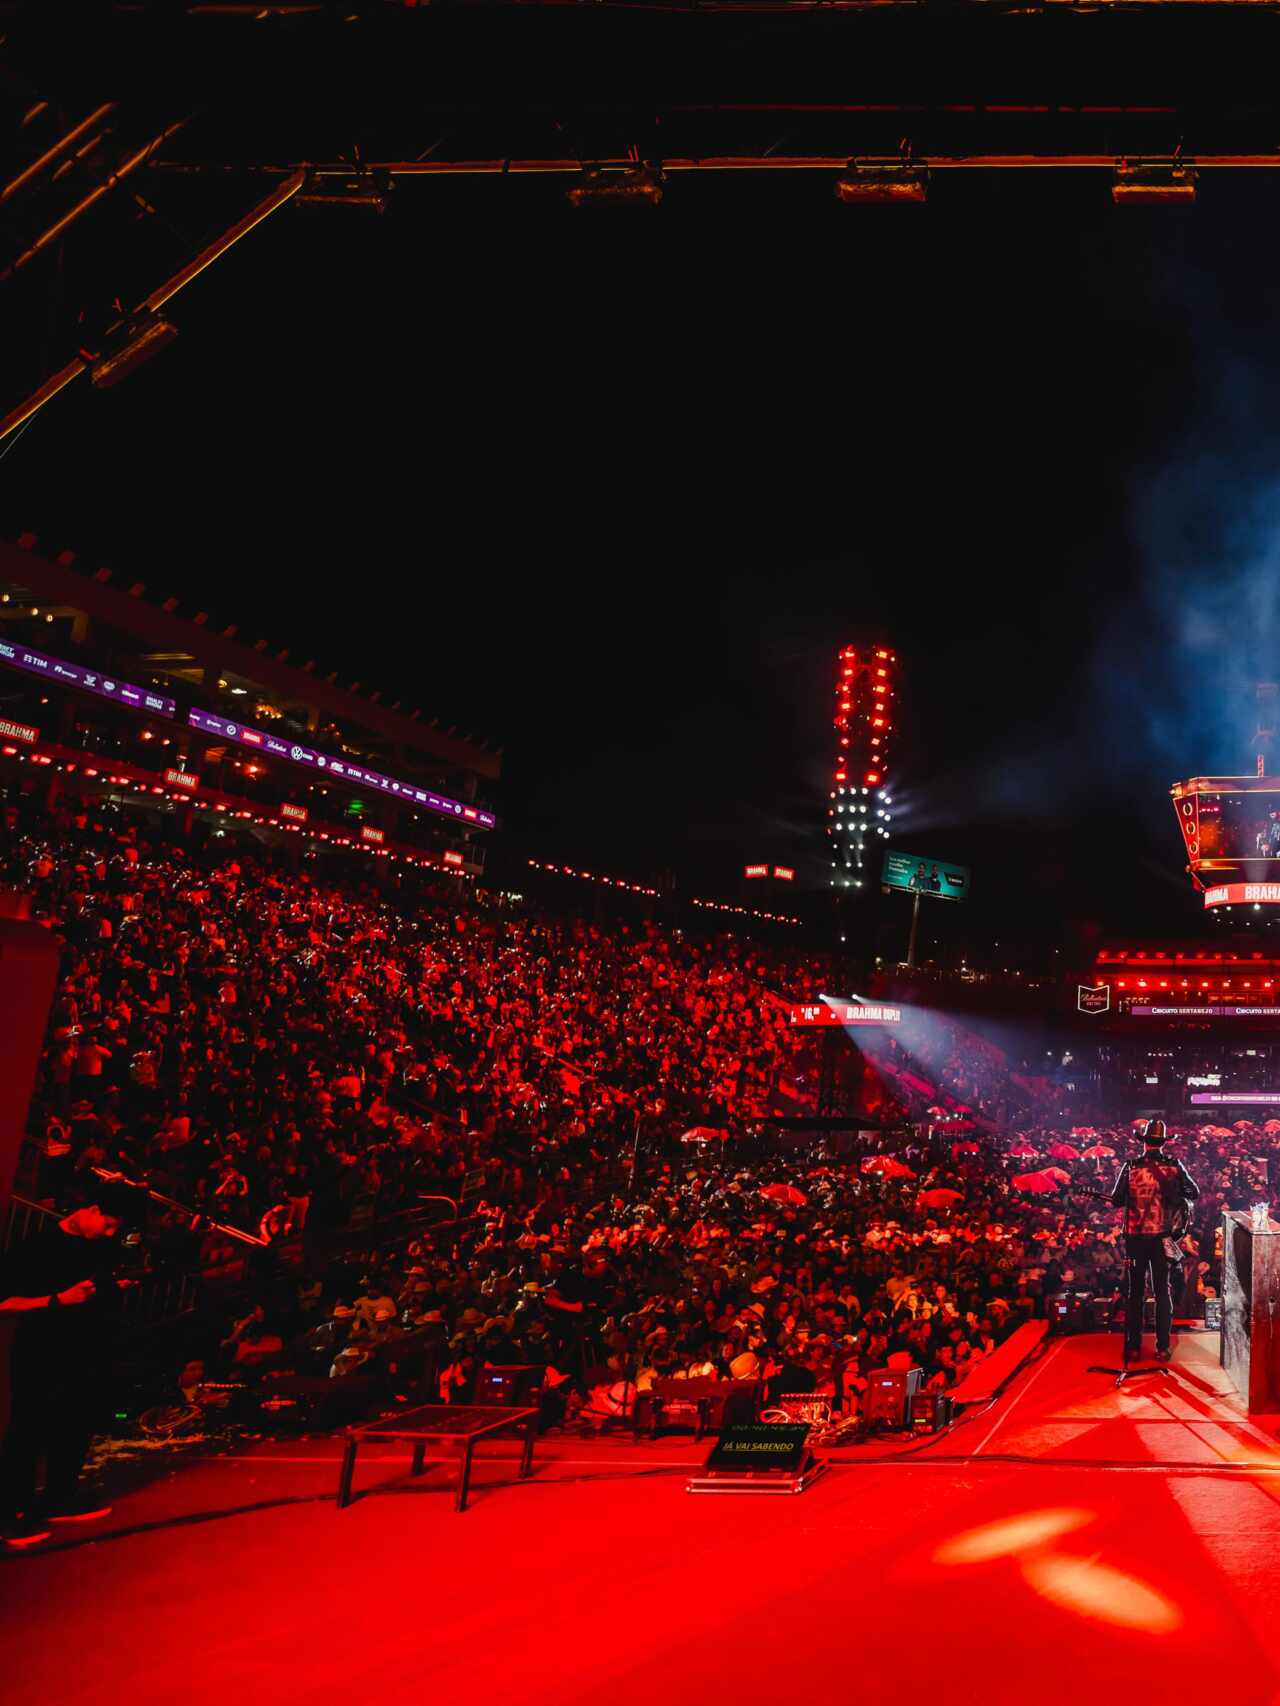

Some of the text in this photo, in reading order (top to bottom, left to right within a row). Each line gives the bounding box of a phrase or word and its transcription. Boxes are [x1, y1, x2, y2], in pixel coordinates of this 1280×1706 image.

[847, 1007, 882, 1020] BRAHMA
[736, 1442, 751, 1450] VAI
[752, 1442, 794, 1450] SABENDO
